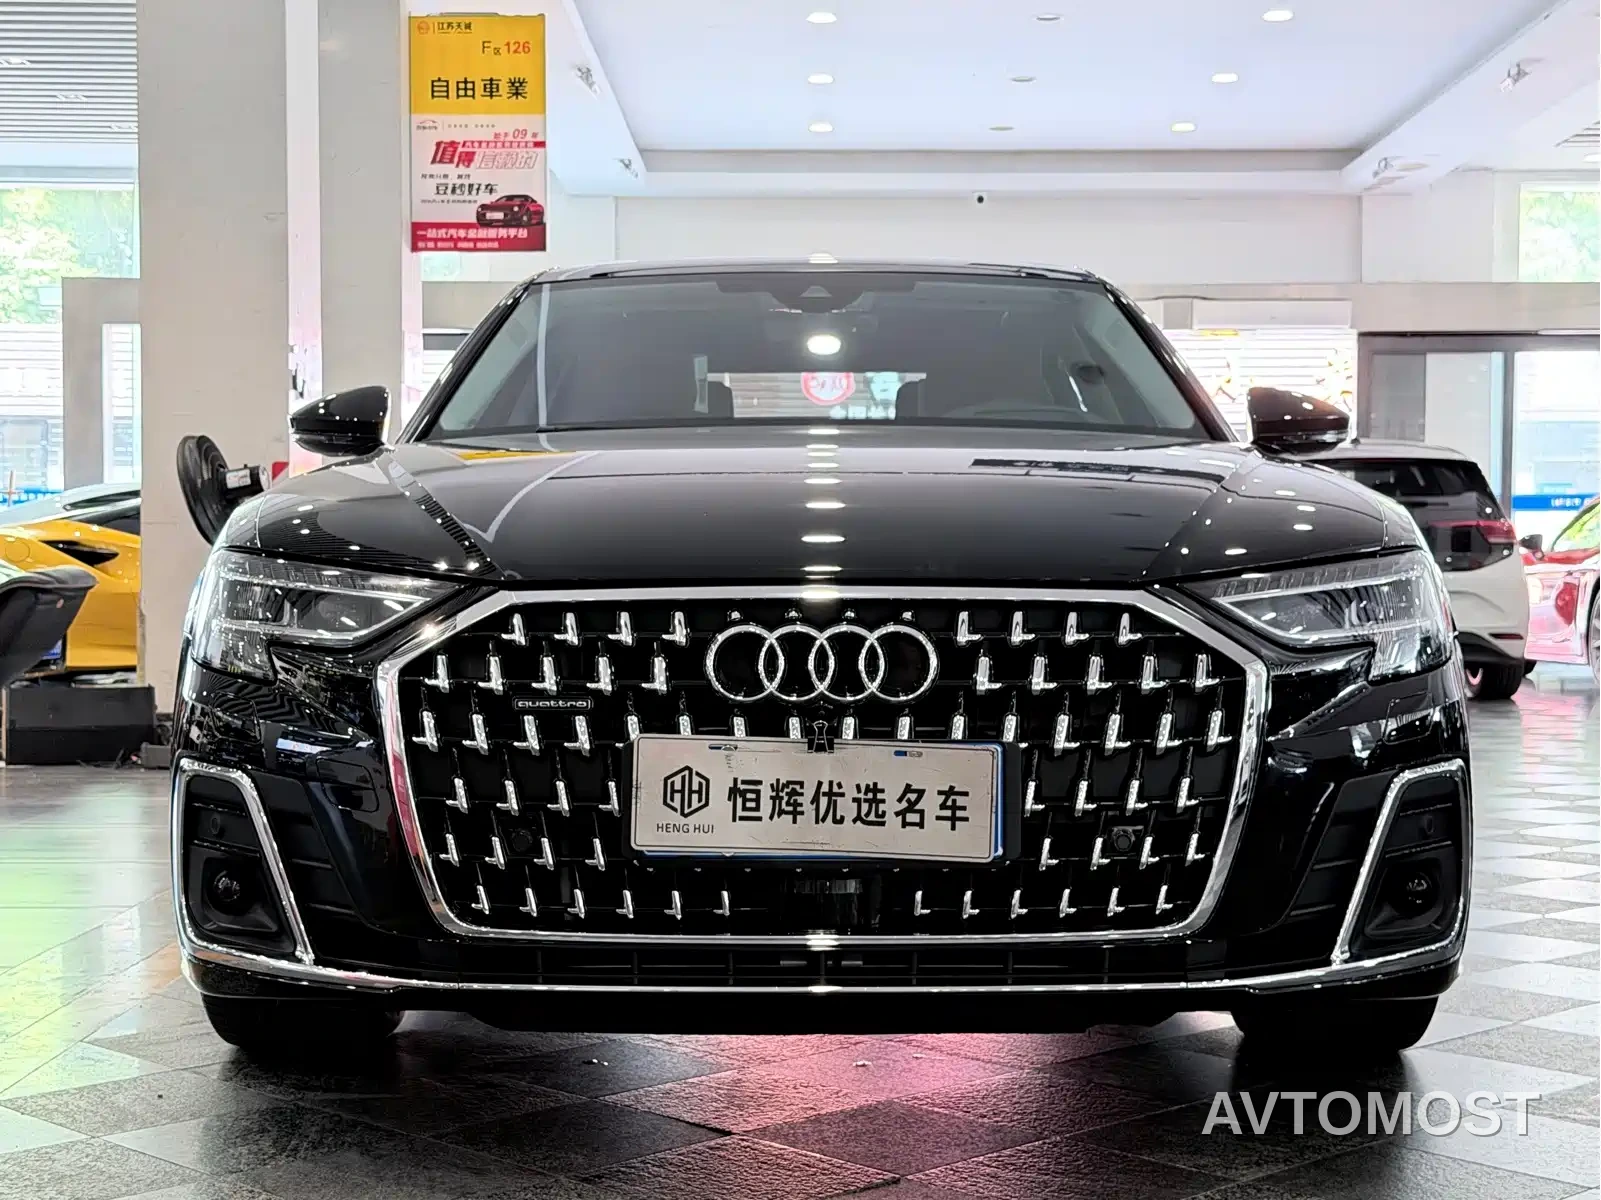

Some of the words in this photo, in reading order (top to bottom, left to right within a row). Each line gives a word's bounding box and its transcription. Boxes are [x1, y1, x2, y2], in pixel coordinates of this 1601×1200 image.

[504, 40, 531, 54] 126
[430, 76, 528, 100] 自由車業
[512, 128, 528, 139] 09
[517, 699, 588, 709] quattro
[727, 776, 970, 831] 恒辉优选名车
[656, 822, 690, 834] HENG
[693, 823, 715, 835] HUI
